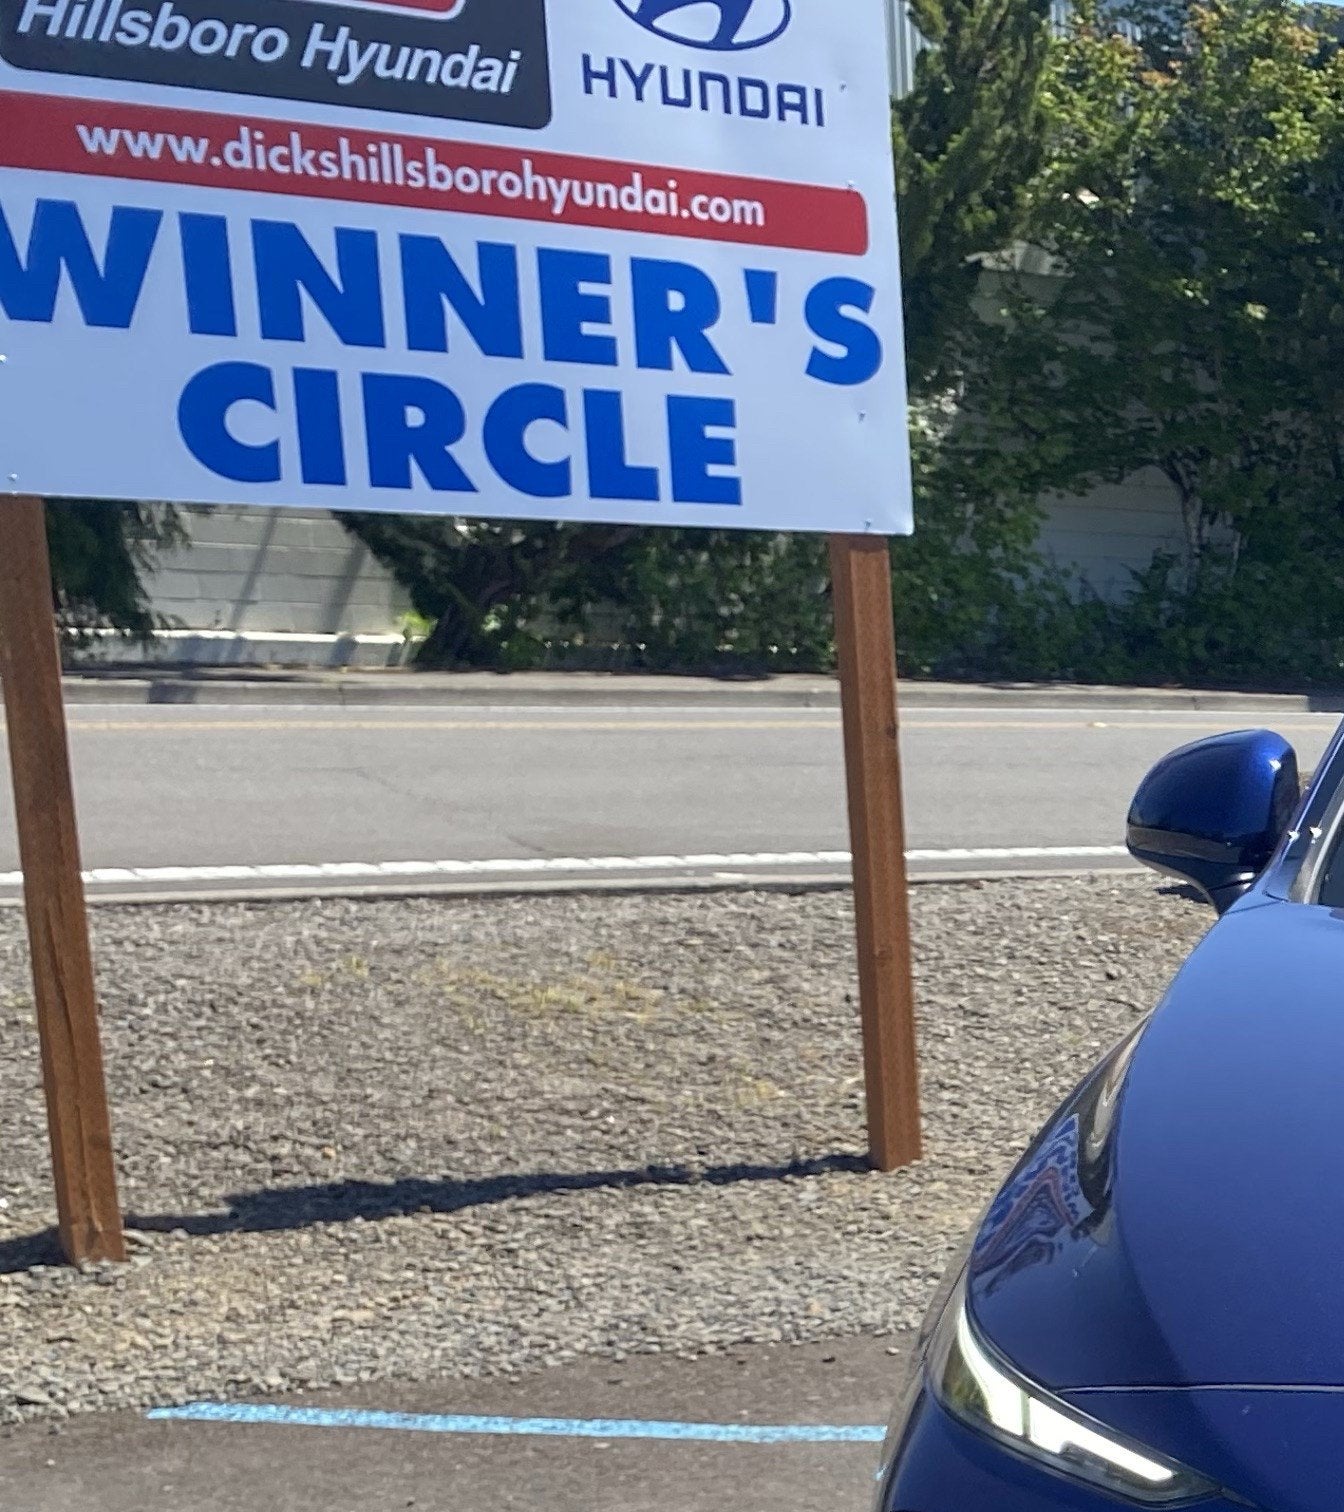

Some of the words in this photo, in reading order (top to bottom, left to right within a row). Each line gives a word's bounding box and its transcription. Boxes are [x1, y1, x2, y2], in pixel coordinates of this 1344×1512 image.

[17, 0, 290, 62] Hillsboro
[301, 22, 522, 94] Hyundai
[582, 53, 827, 128] HYUNDAI
[76, 123, 766, 228] www.dickshillsborohyundai.com
[0, 198, 884, 387] WINNER'S
[177, 361, 744, 507] CIRCLE
